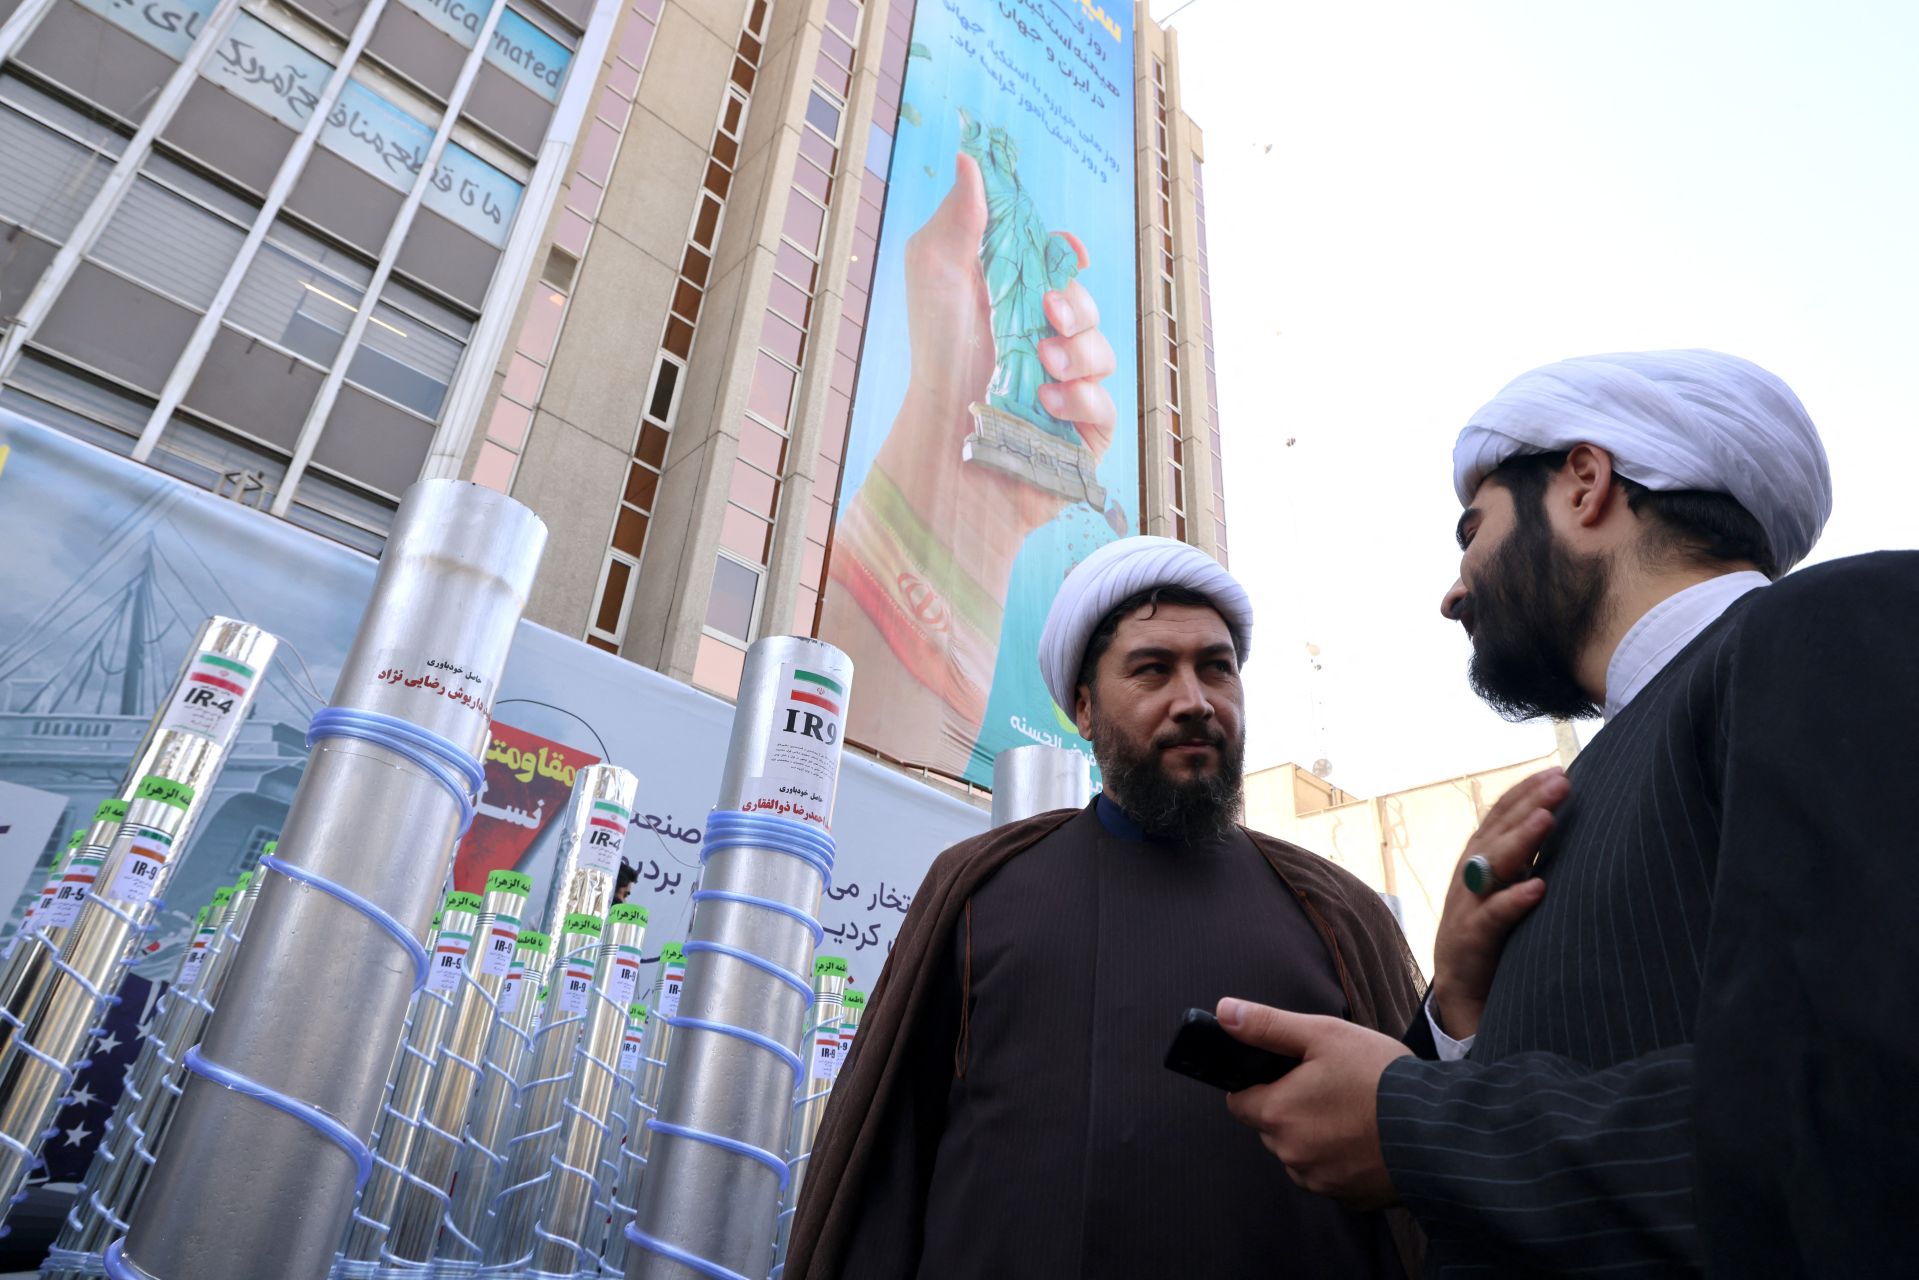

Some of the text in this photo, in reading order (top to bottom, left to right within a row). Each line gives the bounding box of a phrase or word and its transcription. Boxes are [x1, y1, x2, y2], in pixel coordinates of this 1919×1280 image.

[184, 687, 235, 715] IR-4
[782, 708, 839, 746] IR9
[589, 830, 622, 853] IR-4
[132, 860, 159, 881] IR-9
[669, 983, 682, 995] IR-
